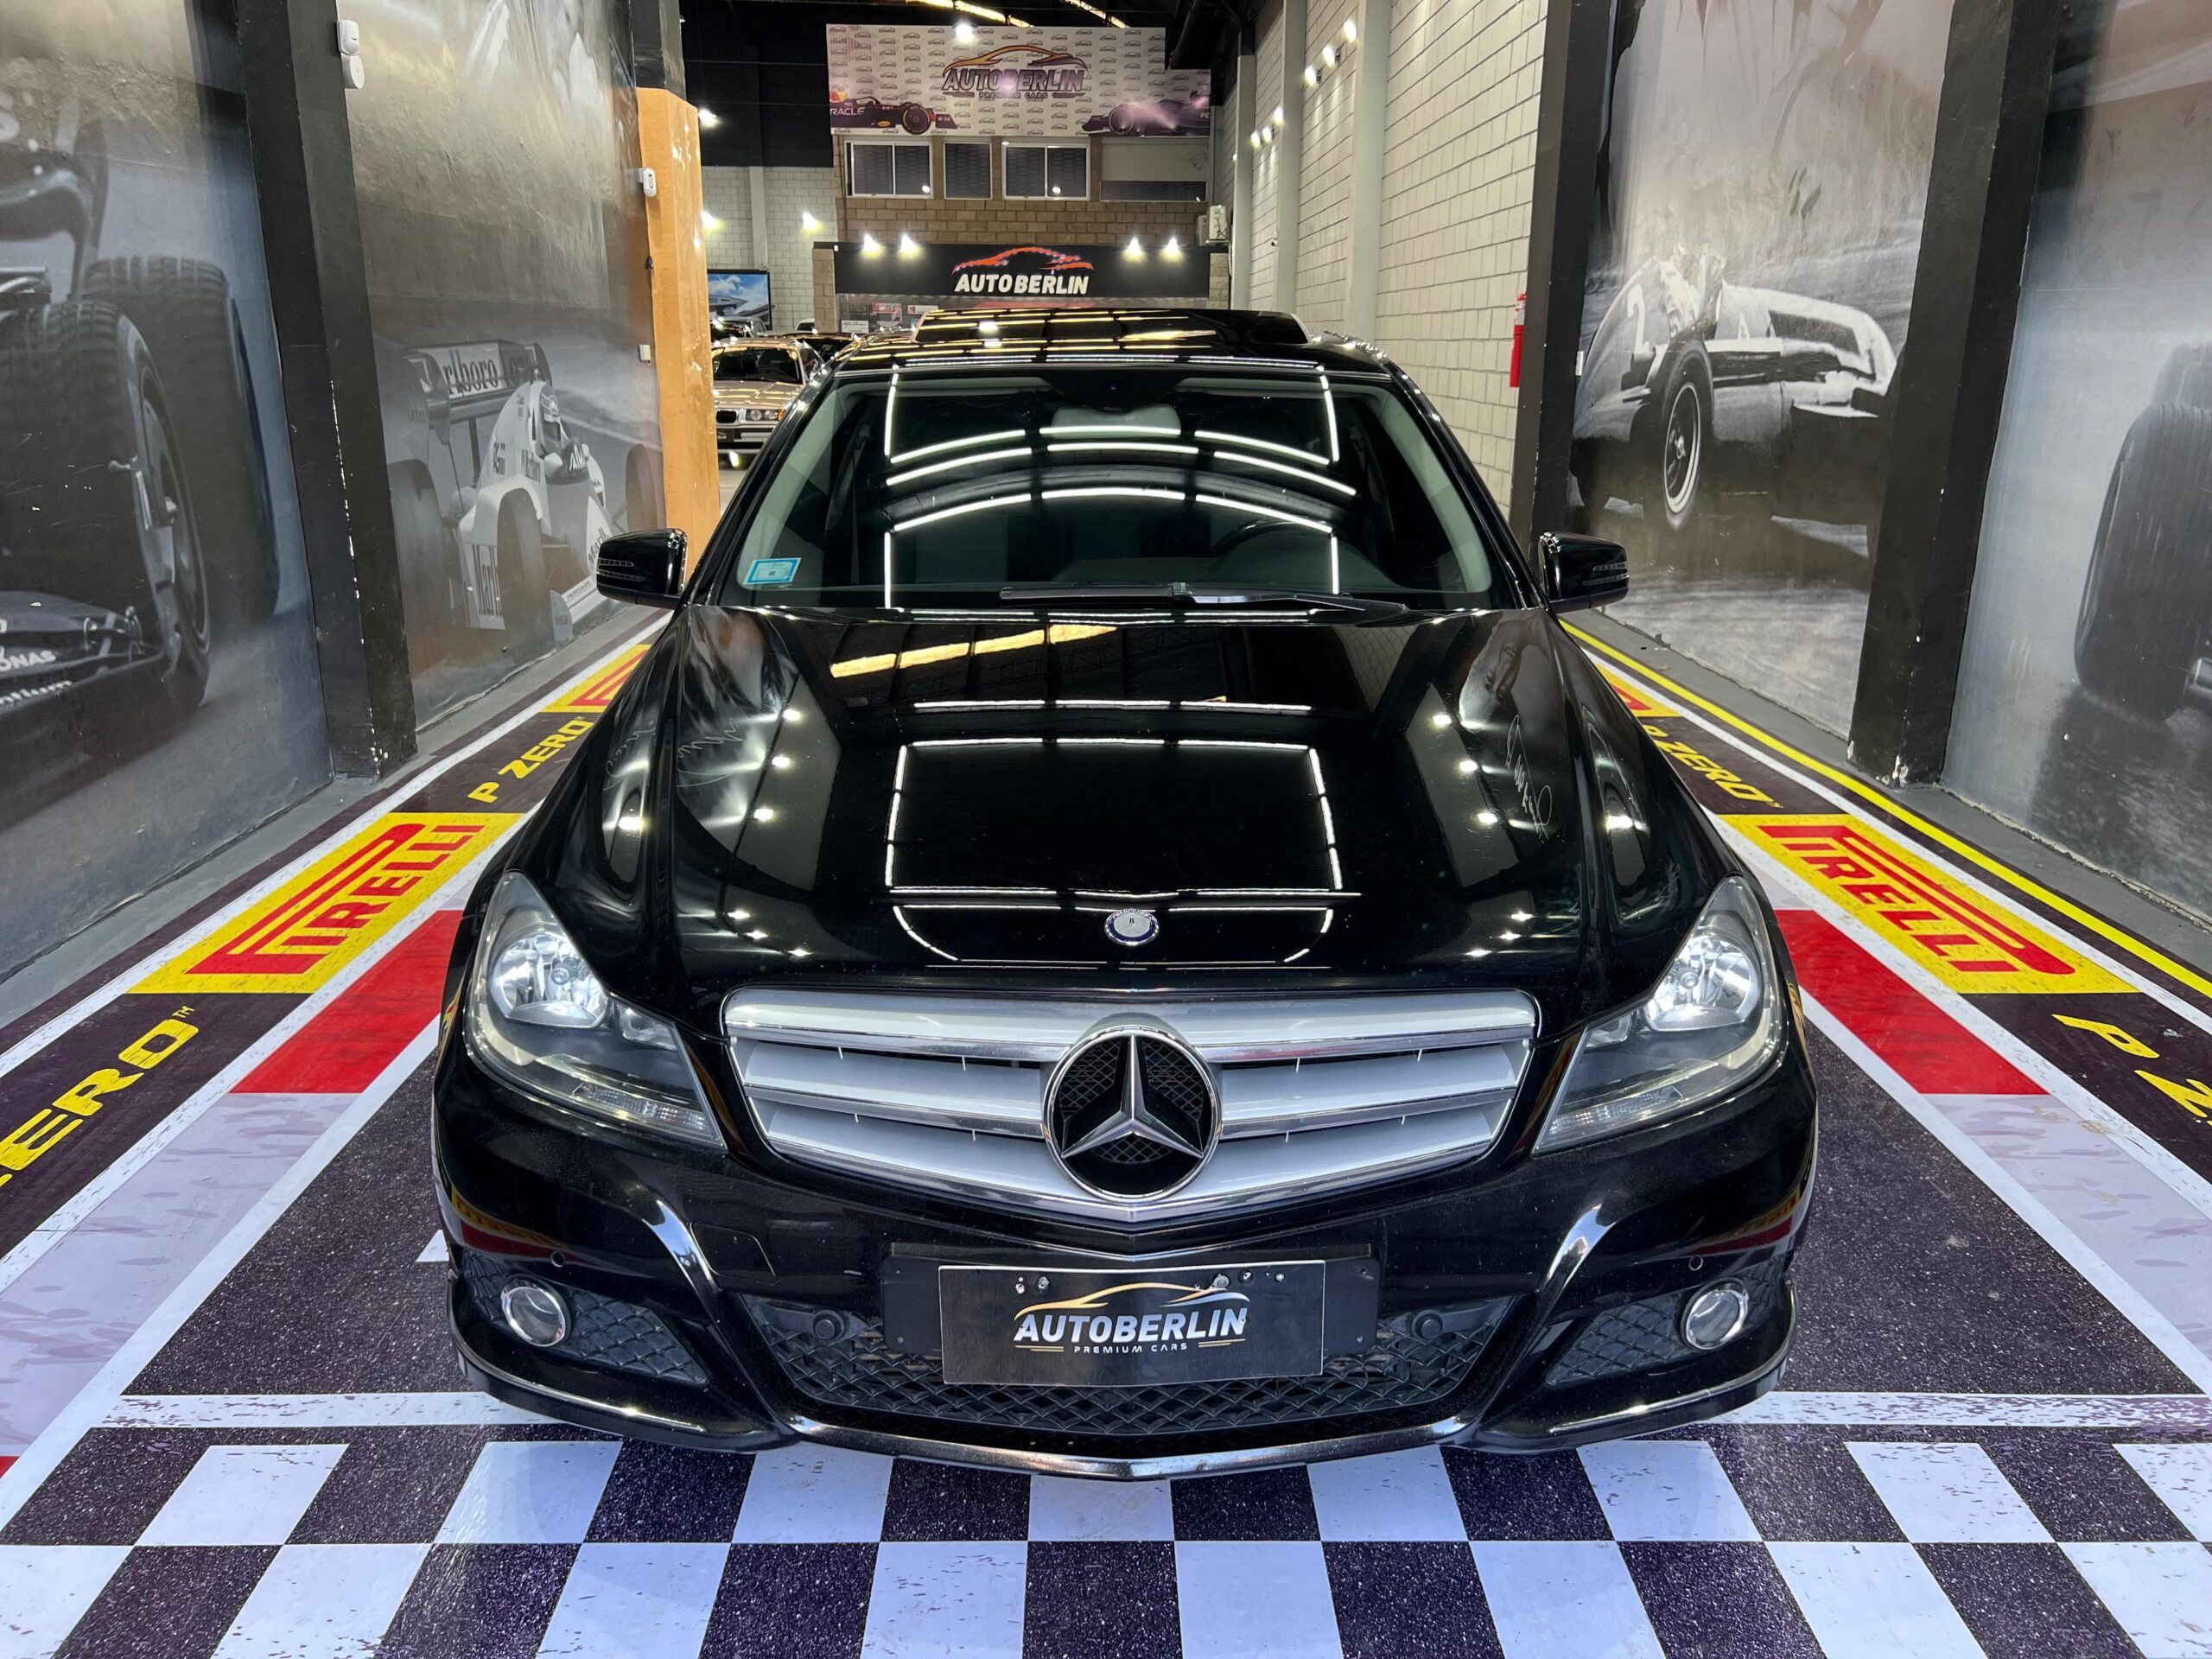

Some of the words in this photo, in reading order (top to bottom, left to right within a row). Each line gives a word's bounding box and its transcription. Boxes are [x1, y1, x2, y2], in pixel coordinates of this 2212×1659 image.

[442, 348, 499, 395] rlboro
[467, 781, 499, 803] P
[497, 719, 594, 779] ZERO
[1654, 739, 1775, 803] ZERO
[183, 823, 486, 974] PIRELLI
[1757, 825, 2075, 975] PIRELLI
[2051, 1014, 2160, 1058] P
[0, 1019, 200, 1188] ERO
[1013, 1307, 1248, 1343] AUTOBERLIN
[1074, 1344, 1142, 1353] PREMIUM
[1151, 1342, 1187, 1352] CARS
